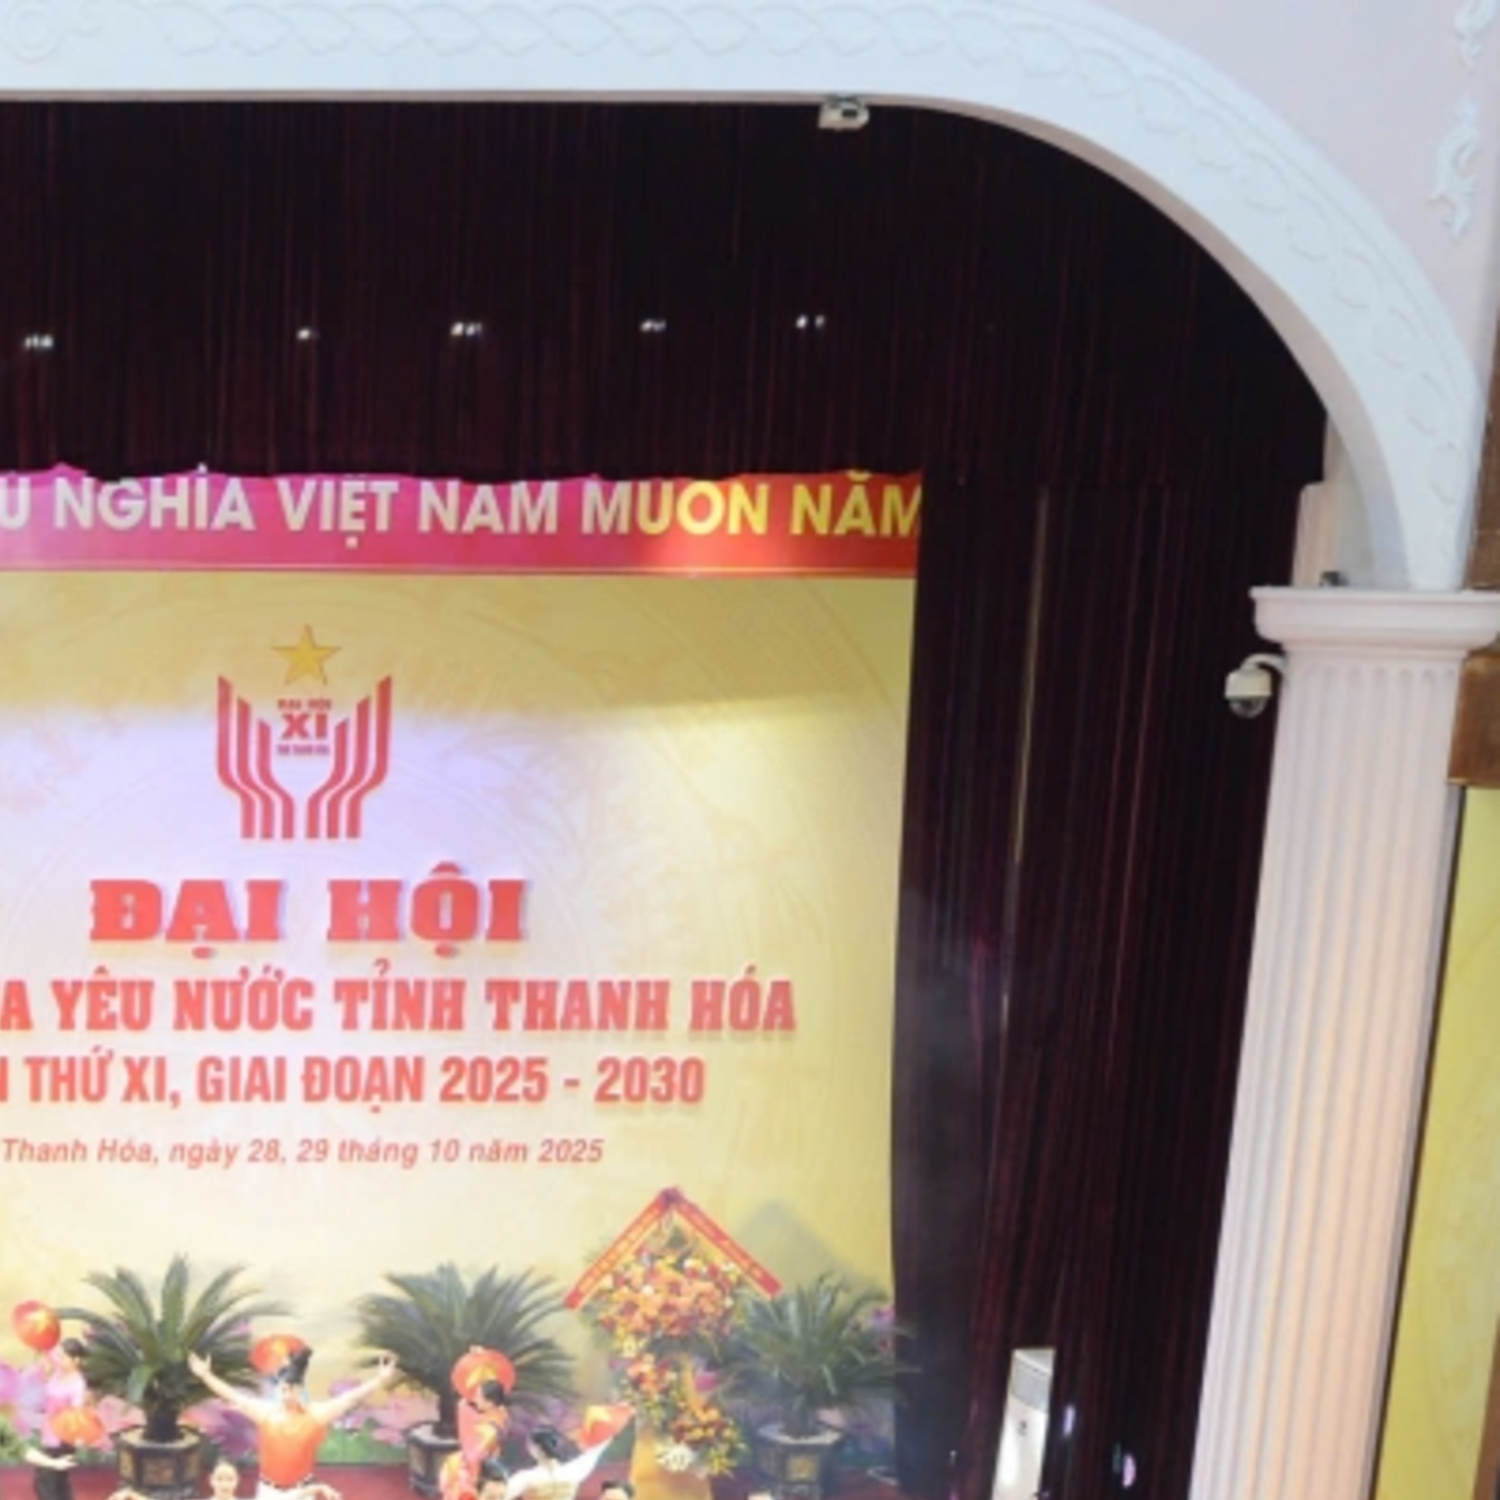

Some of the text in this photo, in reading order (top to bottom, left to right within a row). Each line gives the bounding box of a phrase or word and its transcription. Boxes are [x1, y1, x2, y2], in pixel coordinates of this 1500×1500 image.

[417, 480, 559, 533] NAM
[281, 713, 328, 739] XI
[89, 862, 527, 959] ĐẠI HỘI
[50, 966, 155, 1032] YÊU
[172, 965, 316, 1032] NƯỚC
[333, 958, 467, 1032] TỈNH
[485, 978, 670, 1032] THANH
[689, 965, 796, 1032] HÓA
[24, 1045, 113, 1102] THỨ
[122, 1056, 181, 1107] XI,
[196, 1055, 287, 1102] GIAI
[301, 1055, 424, 1113] ĐOẠN
[439, 1056, 549, 1104] 2025
[594, 1056, 706, 1104] 2030
[3, 1134, 604, 1169] Thanh Hóa, ngày 28, 29 tháng 10 năm 2025
